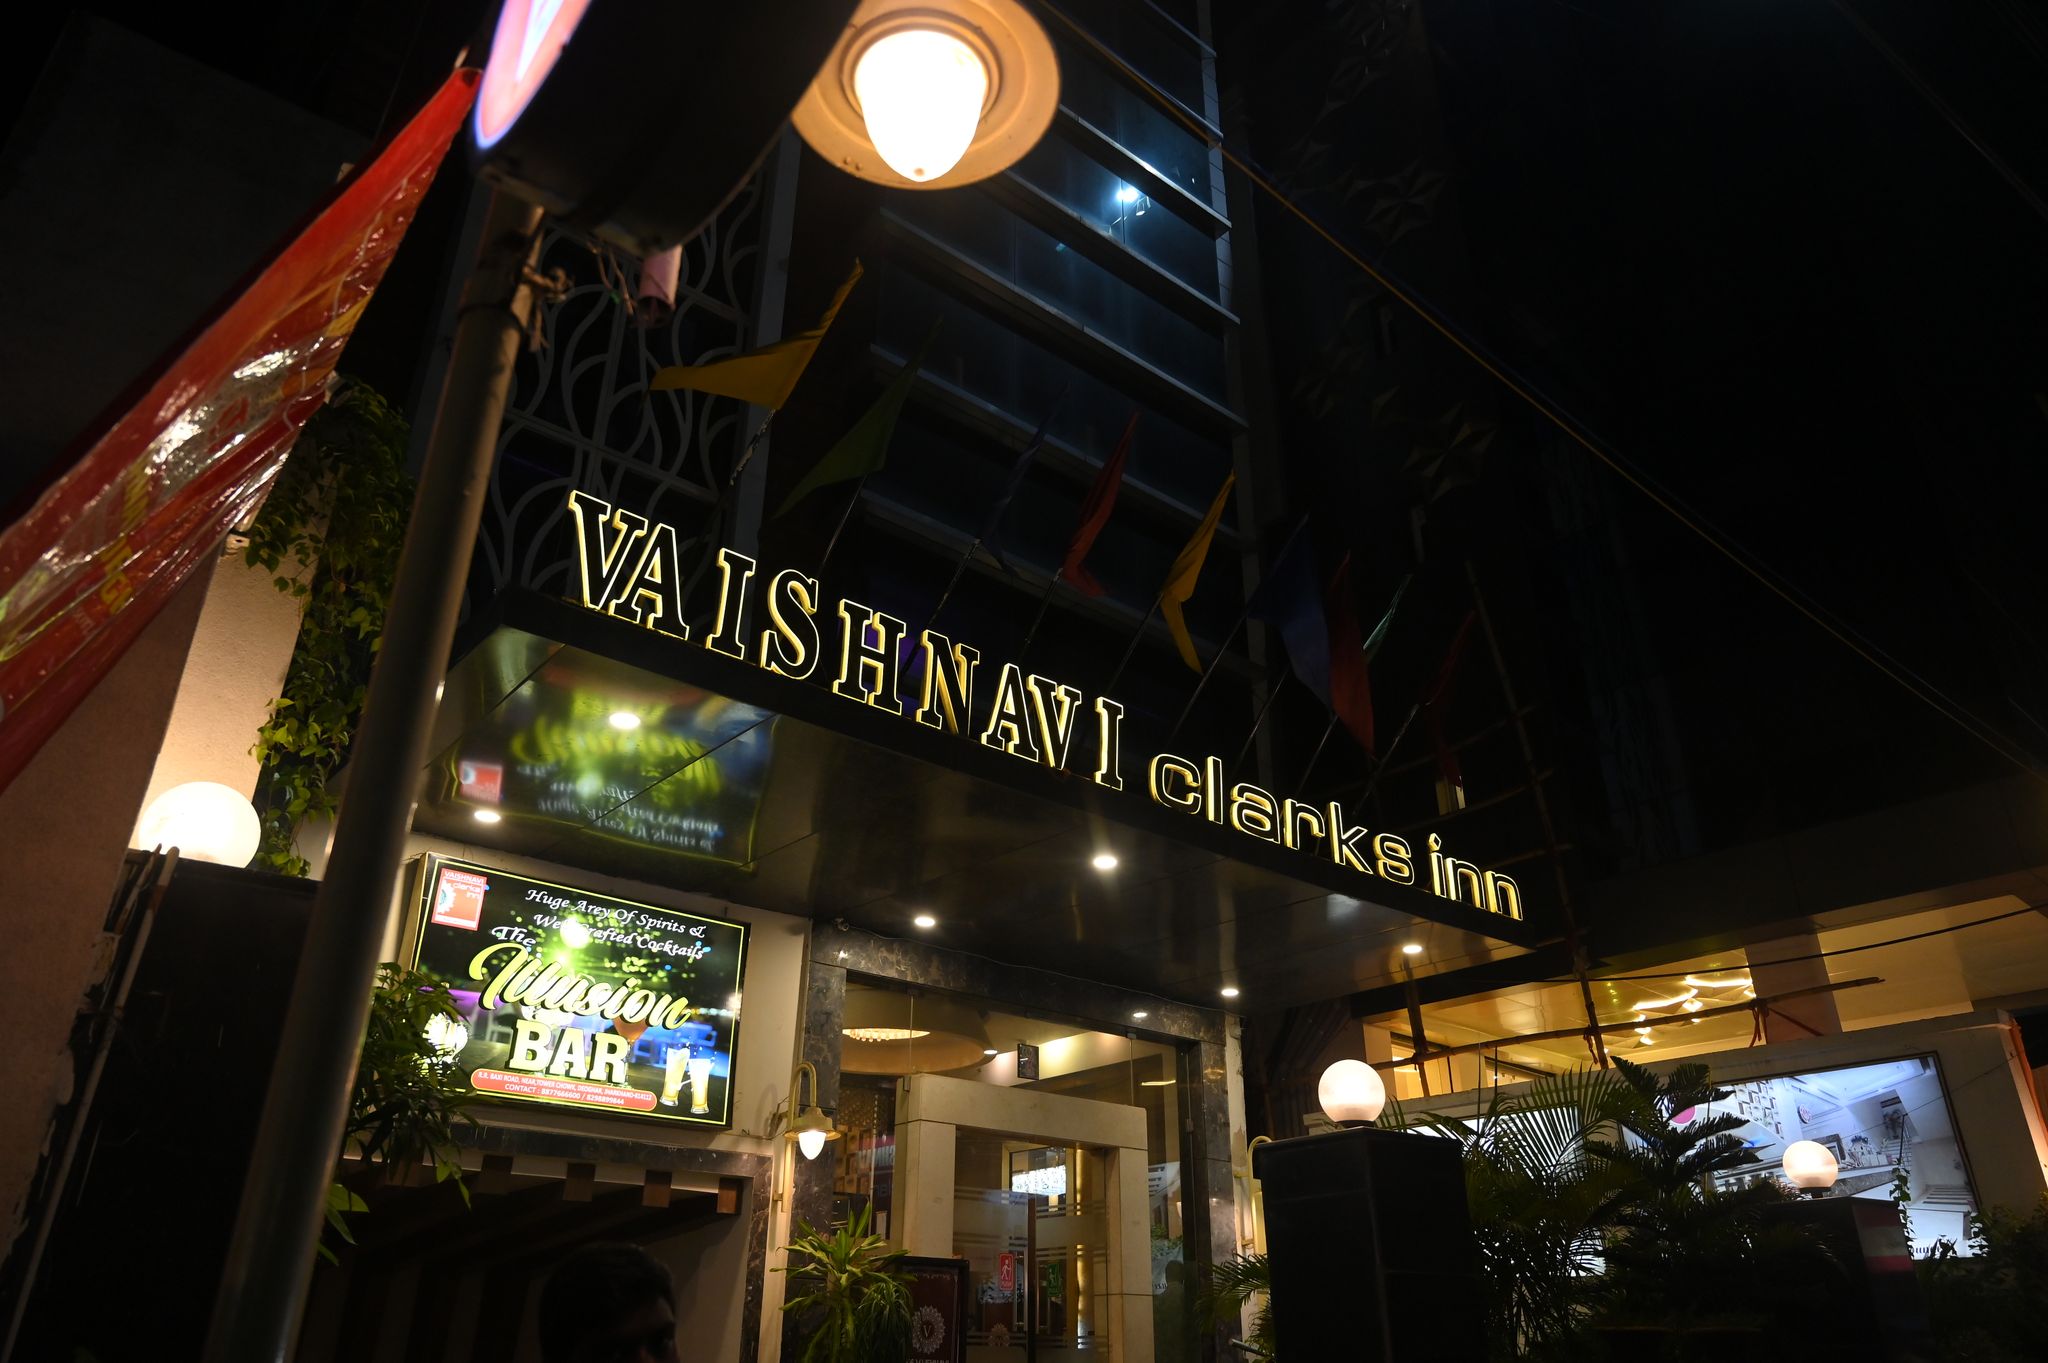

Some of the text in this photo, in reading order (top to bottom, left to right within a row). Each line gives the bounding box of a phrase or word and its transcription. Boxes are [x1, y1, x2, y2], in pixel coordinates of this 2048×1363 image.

[568, 489, 1524, 922] VAISHNAVI clarks inn
[444, 871, 483, 884] VAISHNAVI
[491, 926, 537, 947] The
[524, 889, 706, 939] Huge Arey Of Spirits &
[533, 914, 571, 931] We
[636, 936, 705, 960] Cocktails
[468, 942, 692, 1030] Illusion
[506, 1019, 630, 1085] BAR
[504, 1083, 537, 1094] CONTACT
[922, 1324, 932, 1338] V
